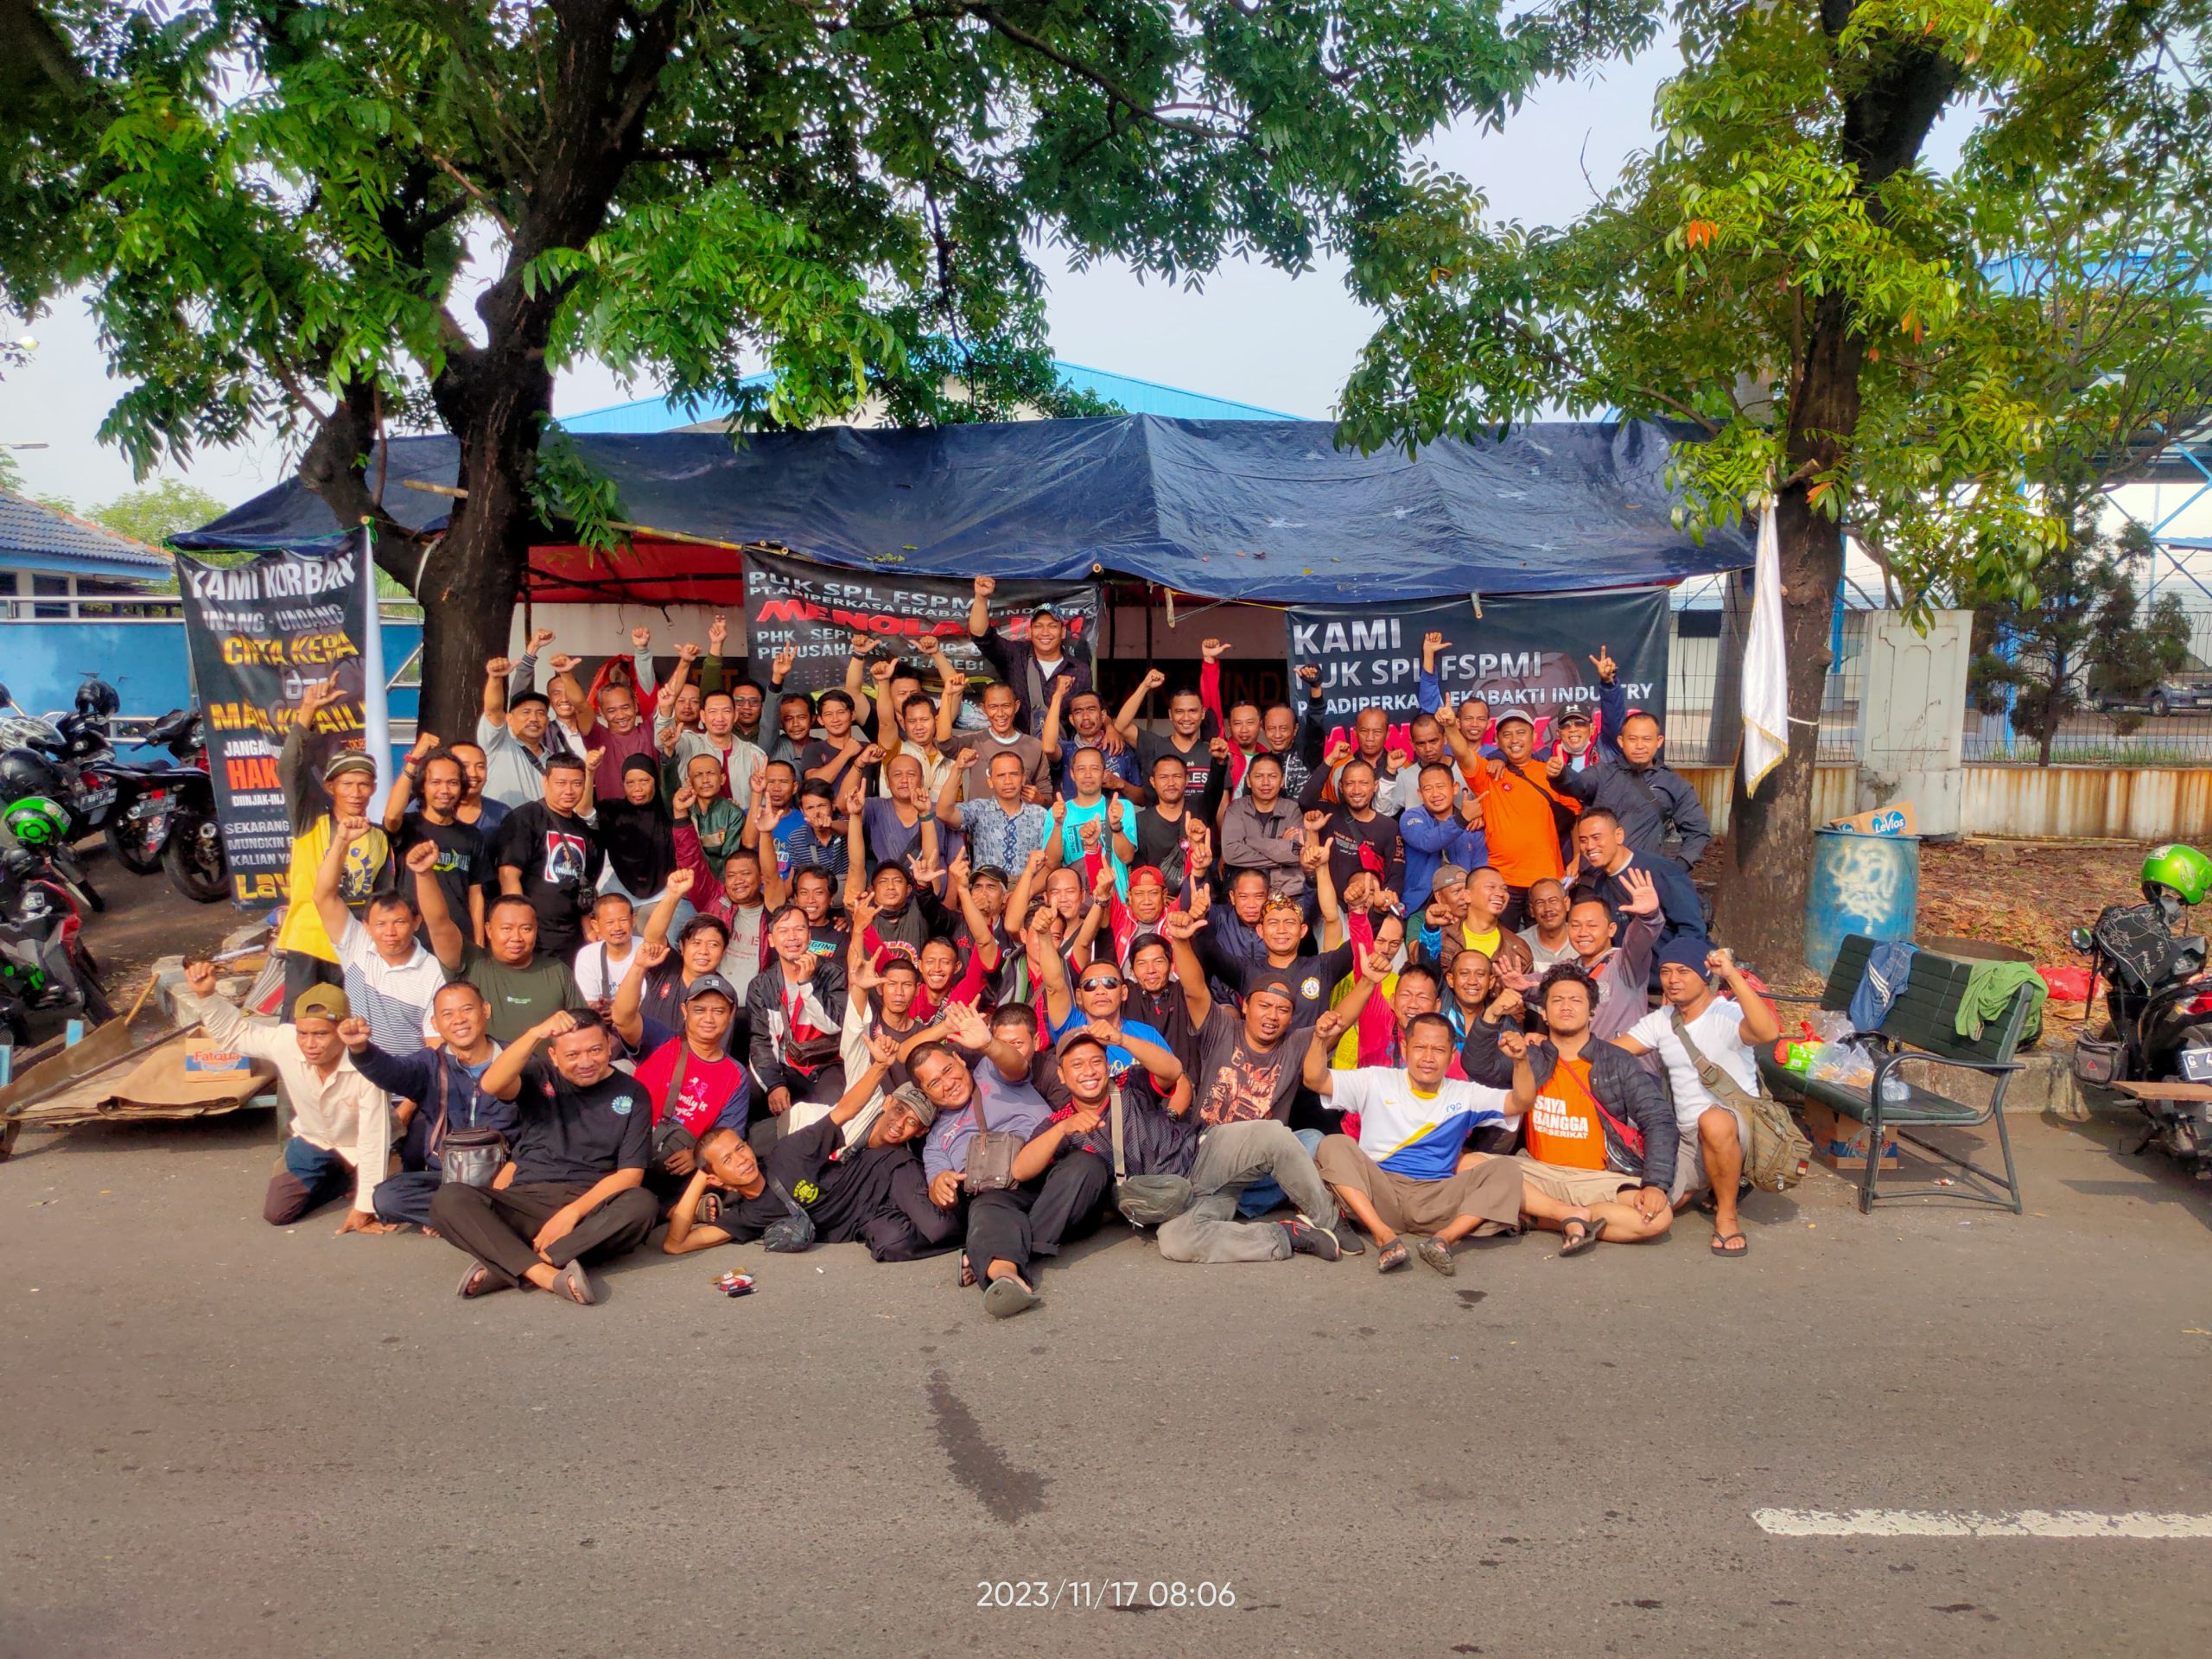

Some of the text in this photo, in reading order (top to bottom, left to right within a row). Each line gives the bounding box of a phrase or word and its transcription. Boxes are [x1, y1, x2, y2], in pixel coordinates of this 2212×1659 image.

[192, 553, 355, 601] KAMI KORBAN
[749, 571, 813, 593] PUK
[823, 582, 881, 602] SPL
[749, 586, 895, 613] PT.ADIPERKASA
[276, 603, 345, 632] UNDANG
[756, 599, 999, 637] MENOLA
[757, 630, 796, 643] PHK
[1294, 618, 1402, 655] KAMI
[1441, 652, 1541, 681] FSPMI
[1451, 686, 1545, 707] EKABAKTI
[1553, 683, 1654, 703] INDURY
[227, 757, 281, 790] HAK
[225, 821, 290, 835] SEKARANG
[1875, 812, 1904, 833] LeVios
[227, 837, 285, 850] MUNGKIN
[230, 853, 276, 867] KALIAN
[1535, 1095, 1567, 1116] SAYA
[1533, 1109, 1589, 1133] BANGGA
